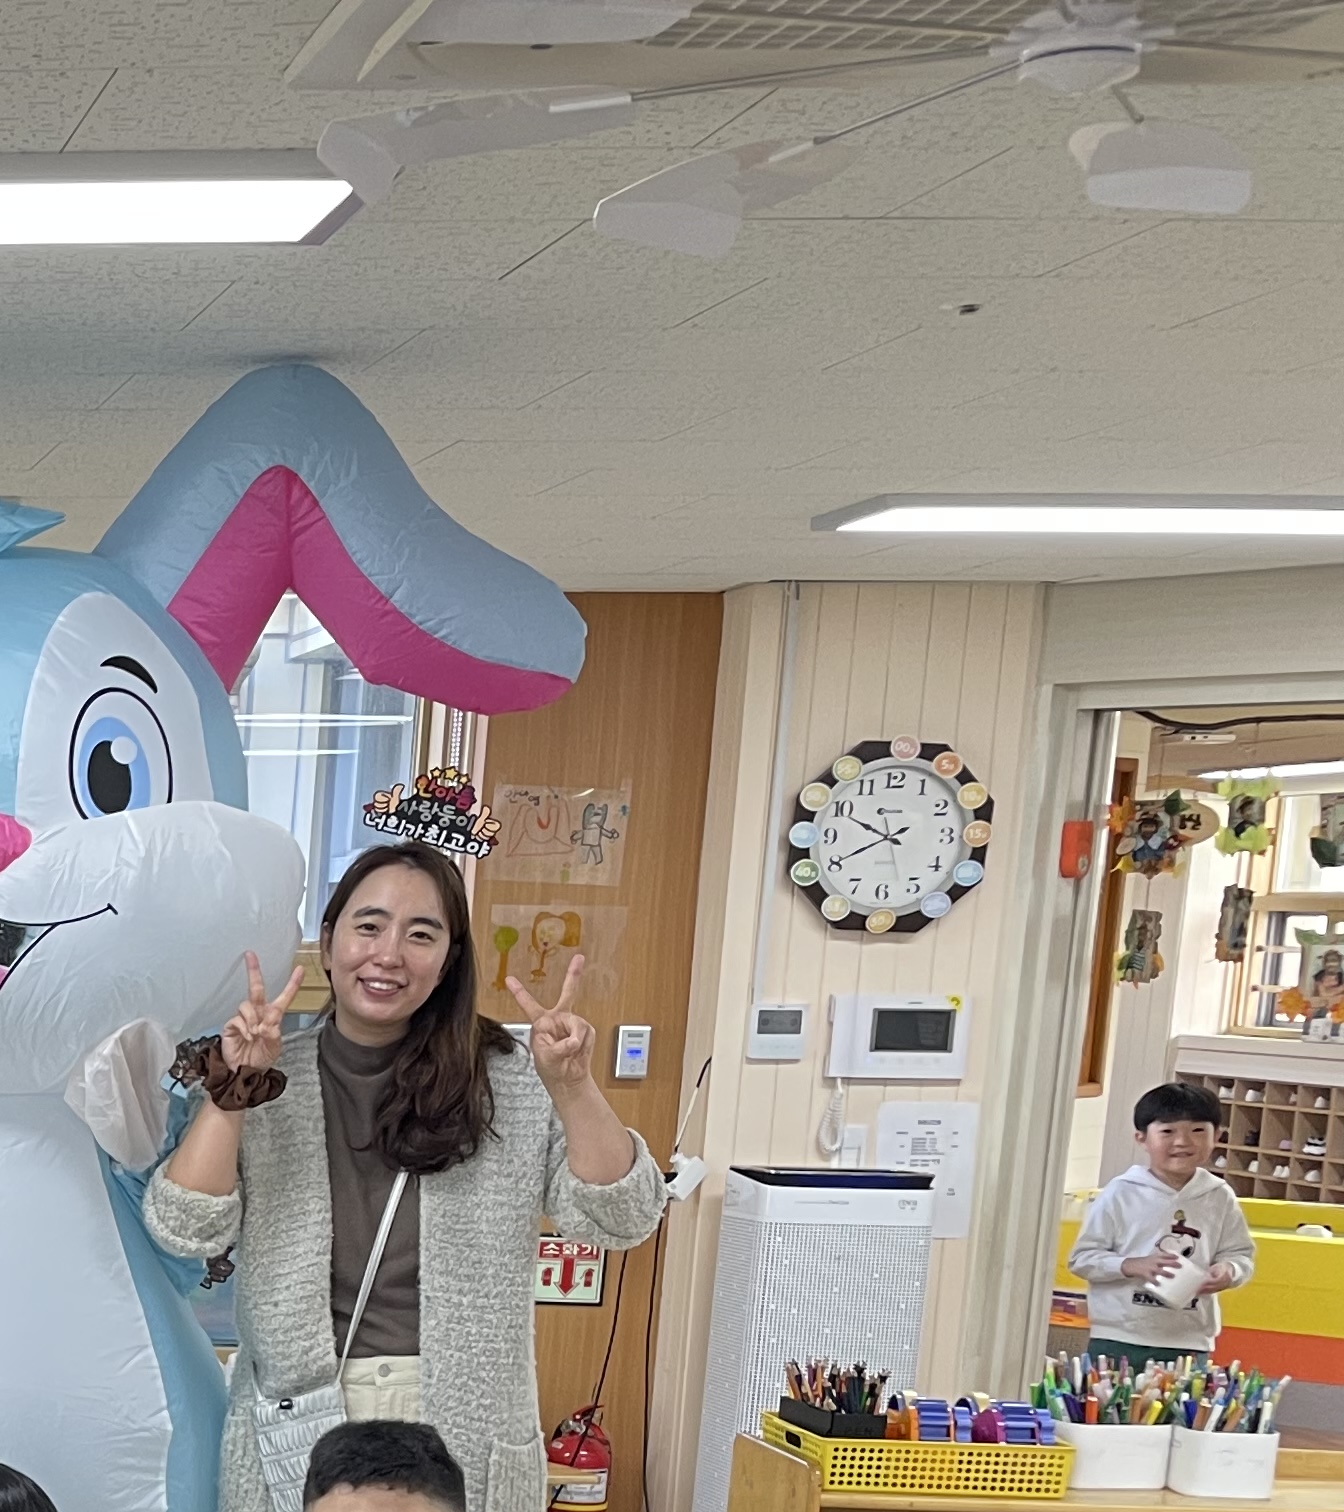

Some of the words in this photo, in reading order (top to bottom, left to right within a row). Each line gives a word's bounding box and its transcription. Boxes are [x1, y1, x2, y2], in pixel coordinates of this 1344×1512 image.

[856, 779, 875, 796] 11
[884, 771, 906, 789] 12
[918, 778, 929, 796] 1
[398, 800, 476, 831] 사랑둥이
[832, 800, 854, 818] 10
[933, 799, 949, 816] 2
[823, 828, 838, 845] 9
[939, 827, 954, 845] 3
[827, 855, 843, 873] 8
[927, 855, 943, 872] 4
[848, 878, 862, 895] 7
[874, 884, 890, 901] 6
[906, 877, 920, 894] 5
[542, 1242, 598, 1256] 소화기
